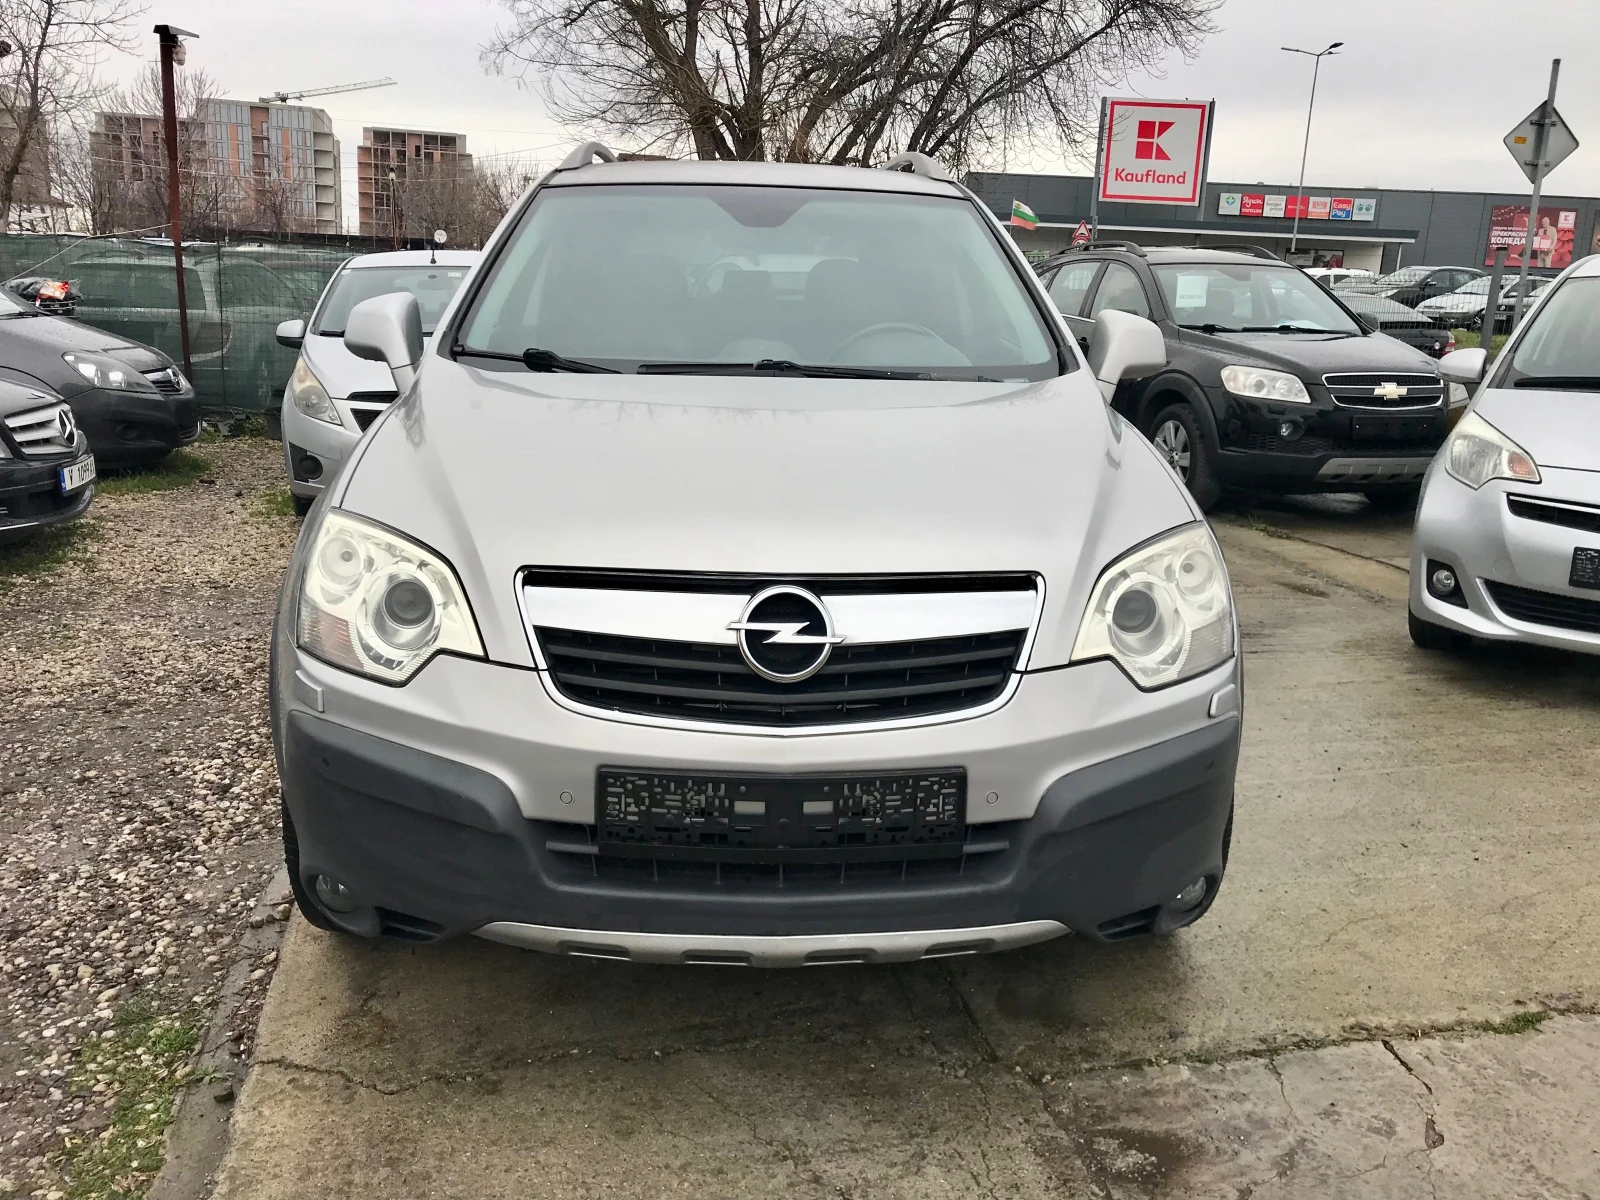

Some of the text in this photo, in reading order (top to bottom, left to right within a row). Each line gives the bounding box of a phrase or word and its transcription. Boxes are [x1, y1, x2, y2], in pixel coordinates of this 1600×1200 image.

[1114, 168, 1187, 184] Kaufland
[1333, 202, 1351, 210] Easy
[1490, 237, 1526, 245] КОЛЕДА
